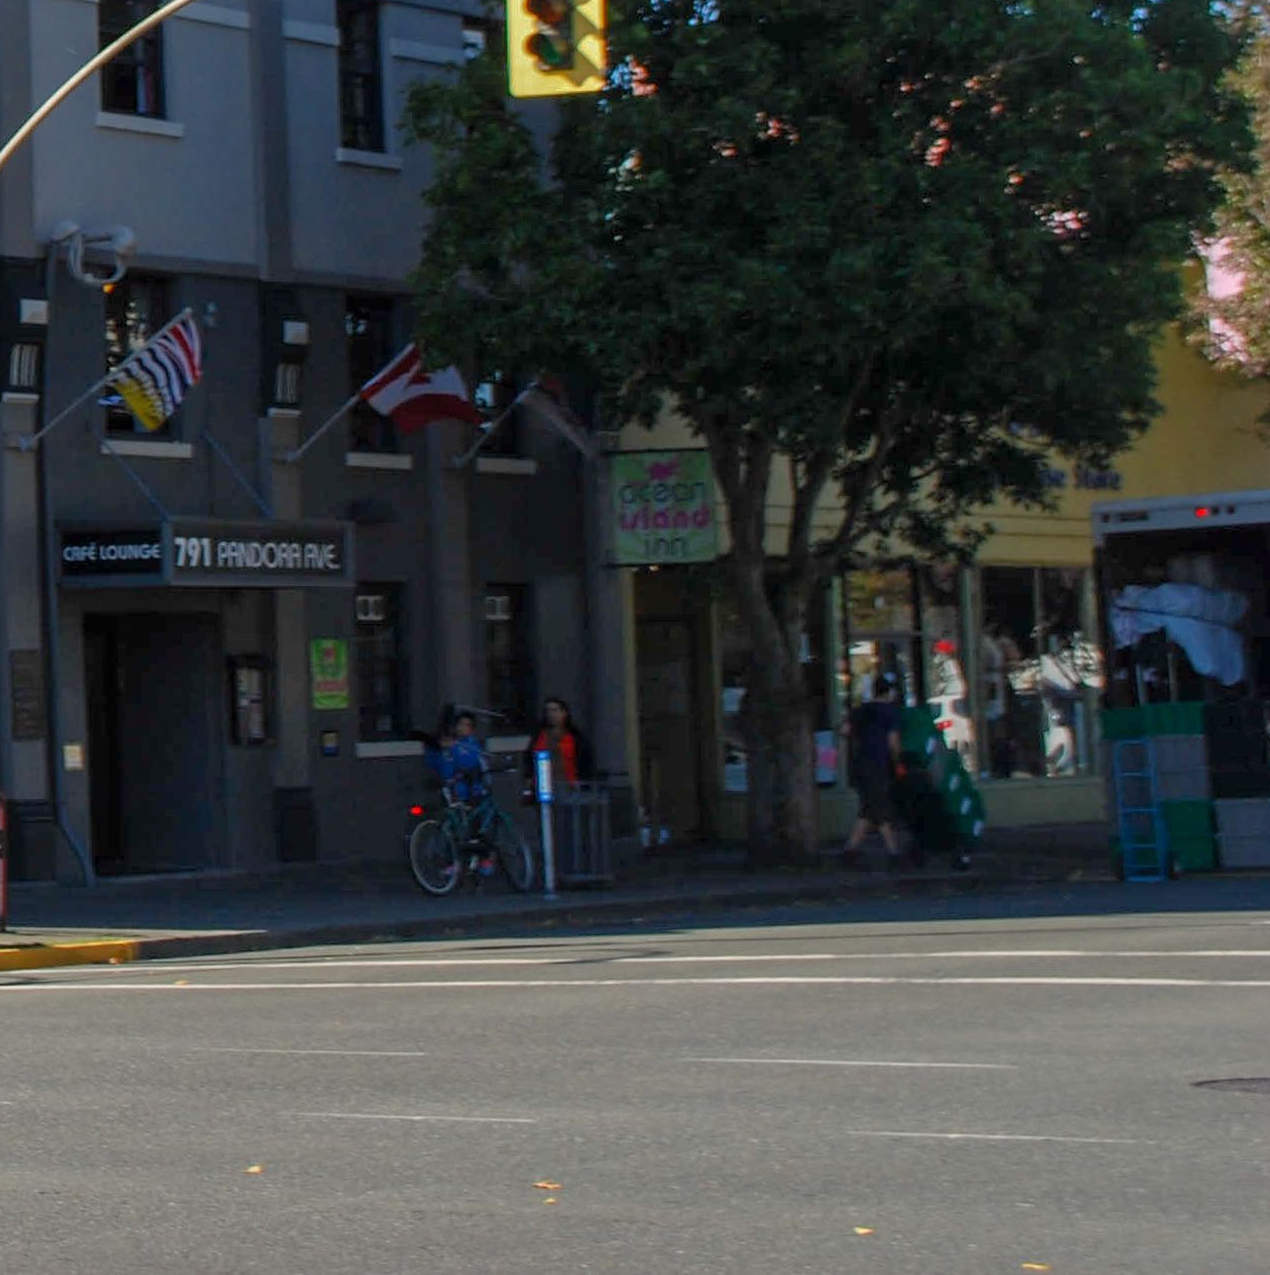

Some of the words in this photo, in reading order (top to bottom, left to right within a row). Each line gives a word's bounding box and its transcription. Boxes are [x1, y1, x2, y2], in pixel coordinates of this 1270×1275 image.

[62, 542, 96, 562] CAFÉ
[99, 543, 161, 561] LOUNGE
[173, 537, 211, 568] 791
[217, 541, 302, 568] PANDORA
